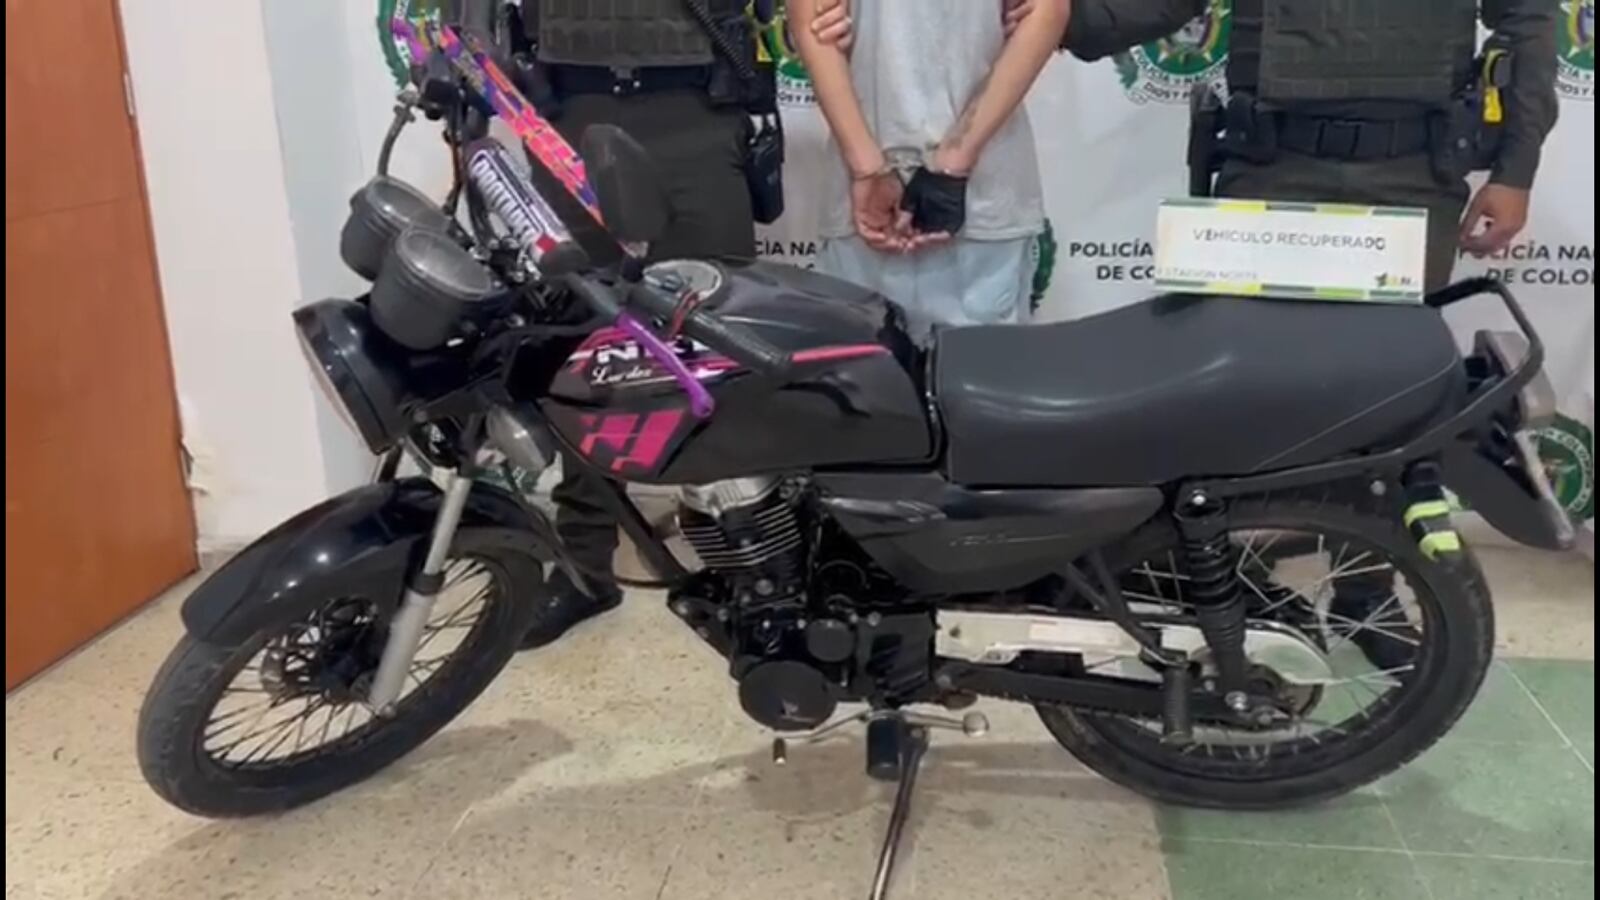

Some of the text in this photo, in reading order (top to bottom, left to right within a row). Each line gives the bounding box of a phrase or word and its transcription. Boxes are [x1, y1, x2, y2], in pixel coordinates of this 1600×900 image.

[1069, 238, 1153, 258] POLICÍA
[1277, 233, 1386, 250] RECUPERADO
[1097, 265, 1124, 280] DE
[1485, 267, 1594, 285] DE COLO
